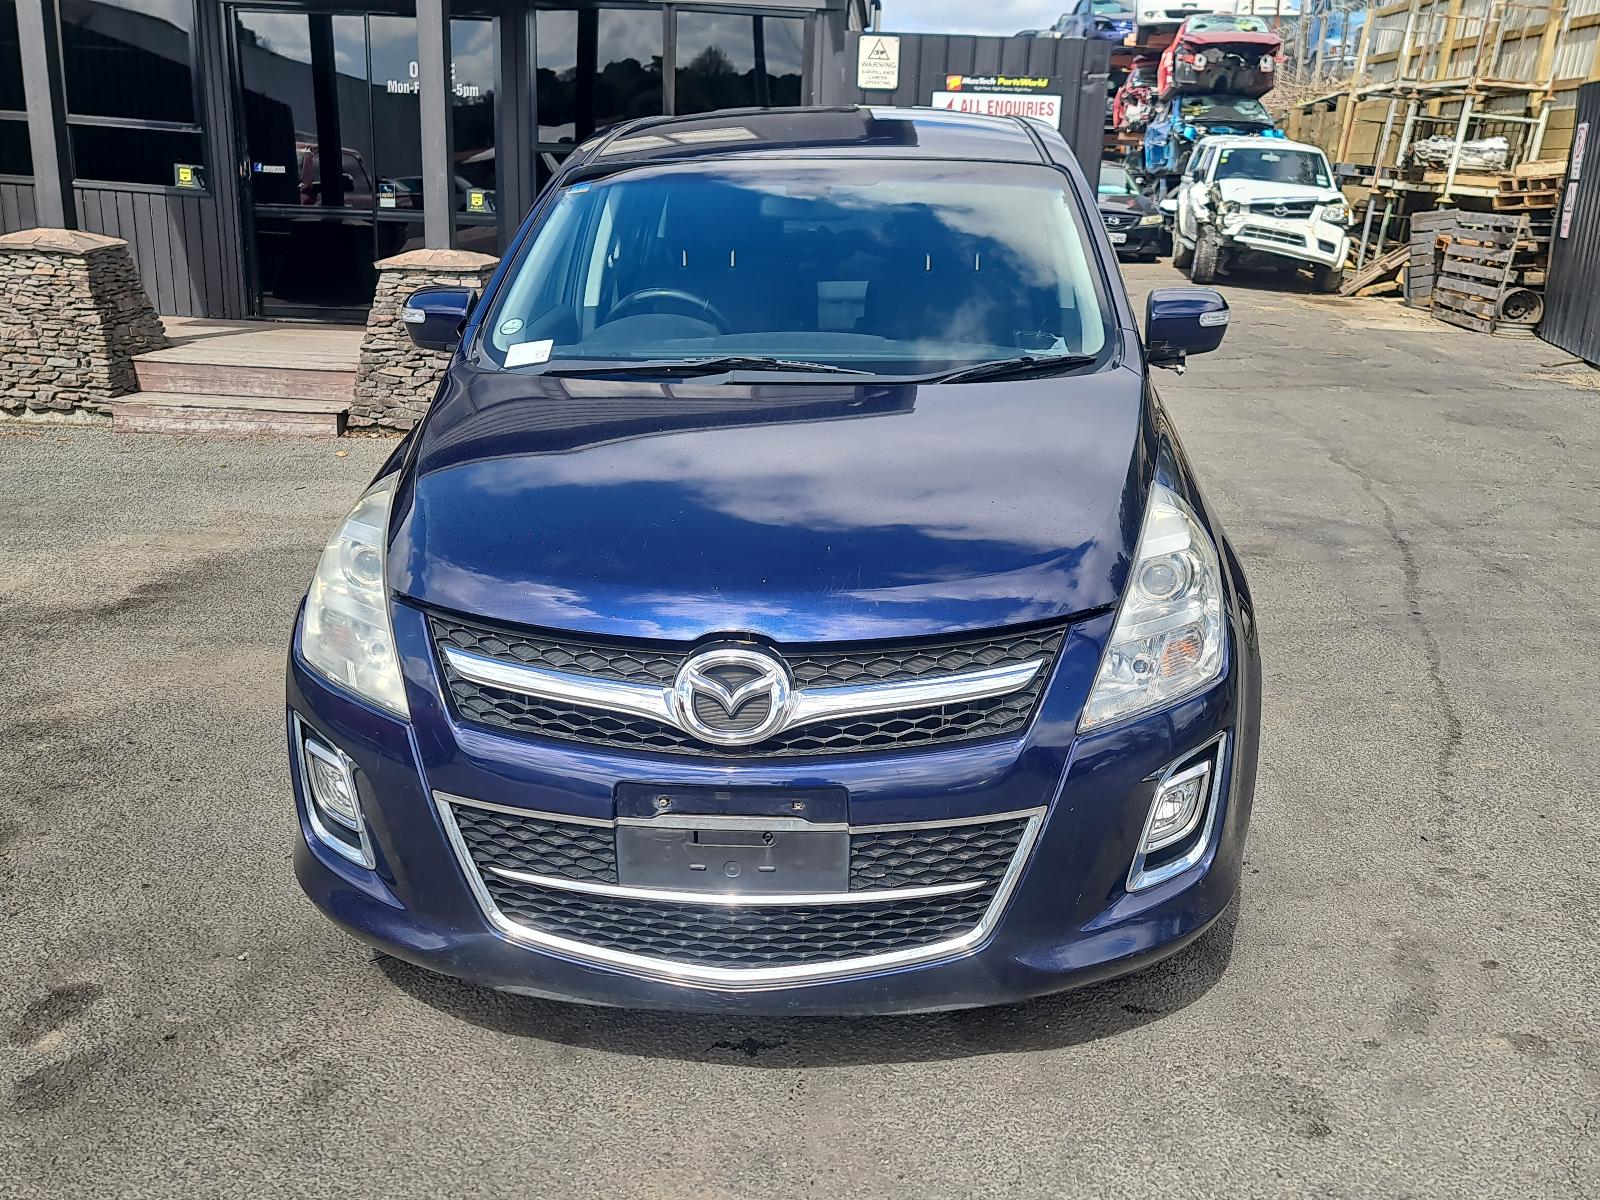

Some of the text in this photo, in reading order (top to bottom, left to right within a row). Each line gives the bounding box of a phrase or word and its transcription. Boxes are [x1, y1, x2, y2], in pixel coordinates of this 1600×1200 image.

[997, 77, 1048, 88] PartsWorld
[961, 99, 1055, 117] ALL ENQUIRIES
